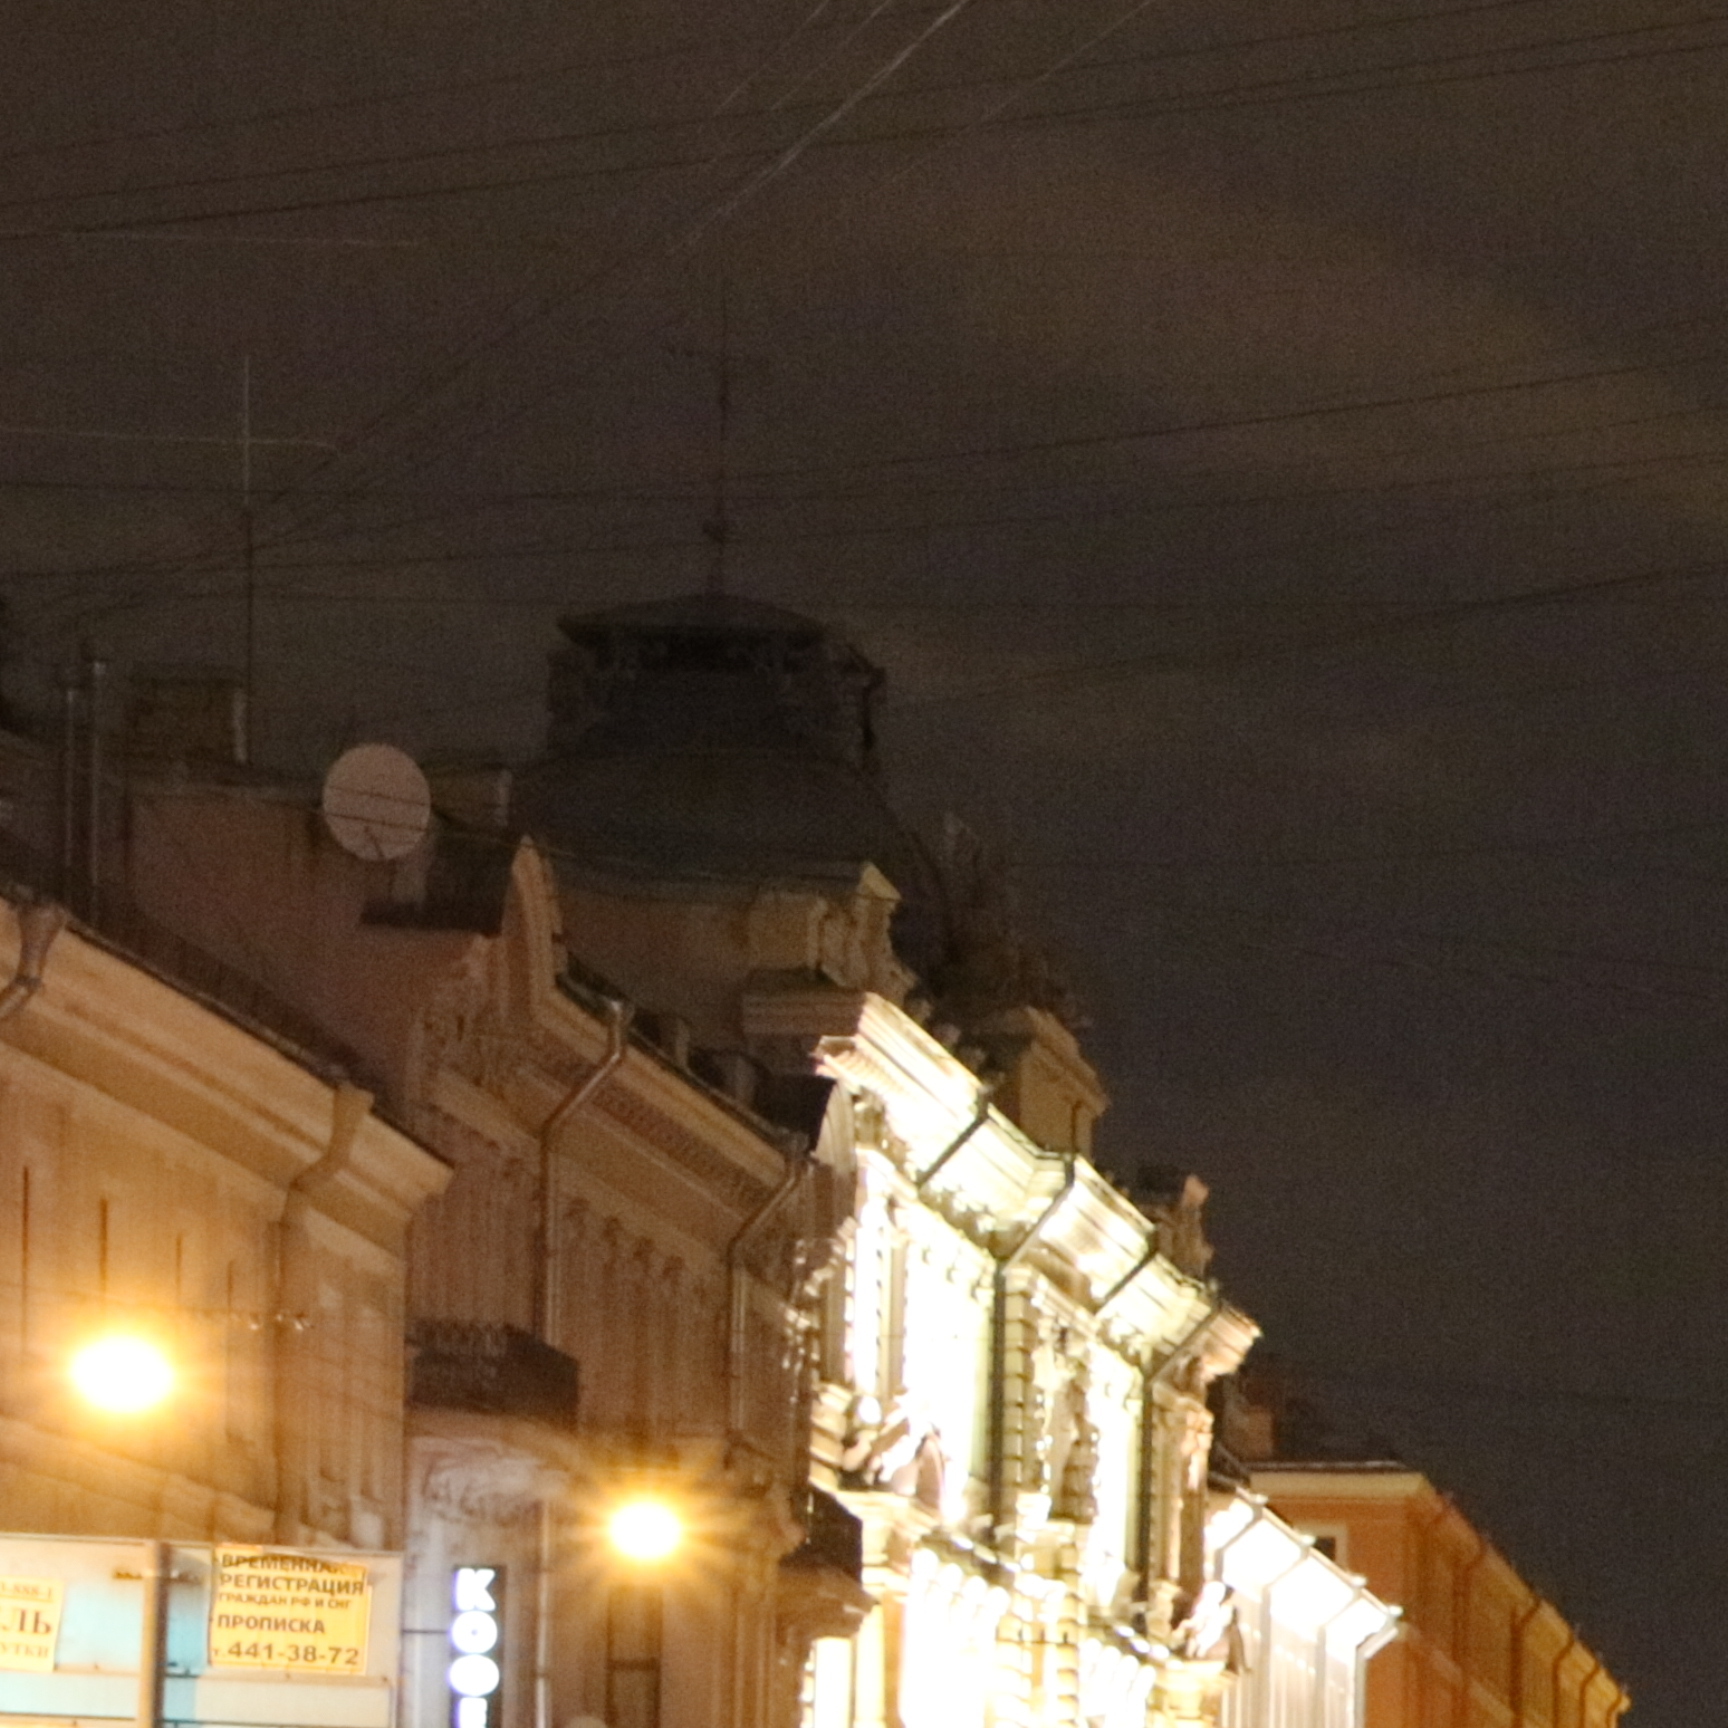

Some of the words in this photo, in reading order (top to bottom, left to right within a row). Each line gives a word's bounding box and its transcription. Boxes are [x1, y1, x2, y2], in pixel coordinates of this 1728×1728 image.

[219, 1573, 364, 1597] РЕГИСТРАЦИЯ
[219, 1592, 288, 1606] ГРАЖДАН
[290, 1596, 311, 1607] РФ
[327, 1599, 350, 1610] СНГ
[0, 1608, 52, 1635] ЛЬ
[217, 1613, 326, 1635] ПРОПИСКА
[227, 1642, 360, 1666] 441-38-72
